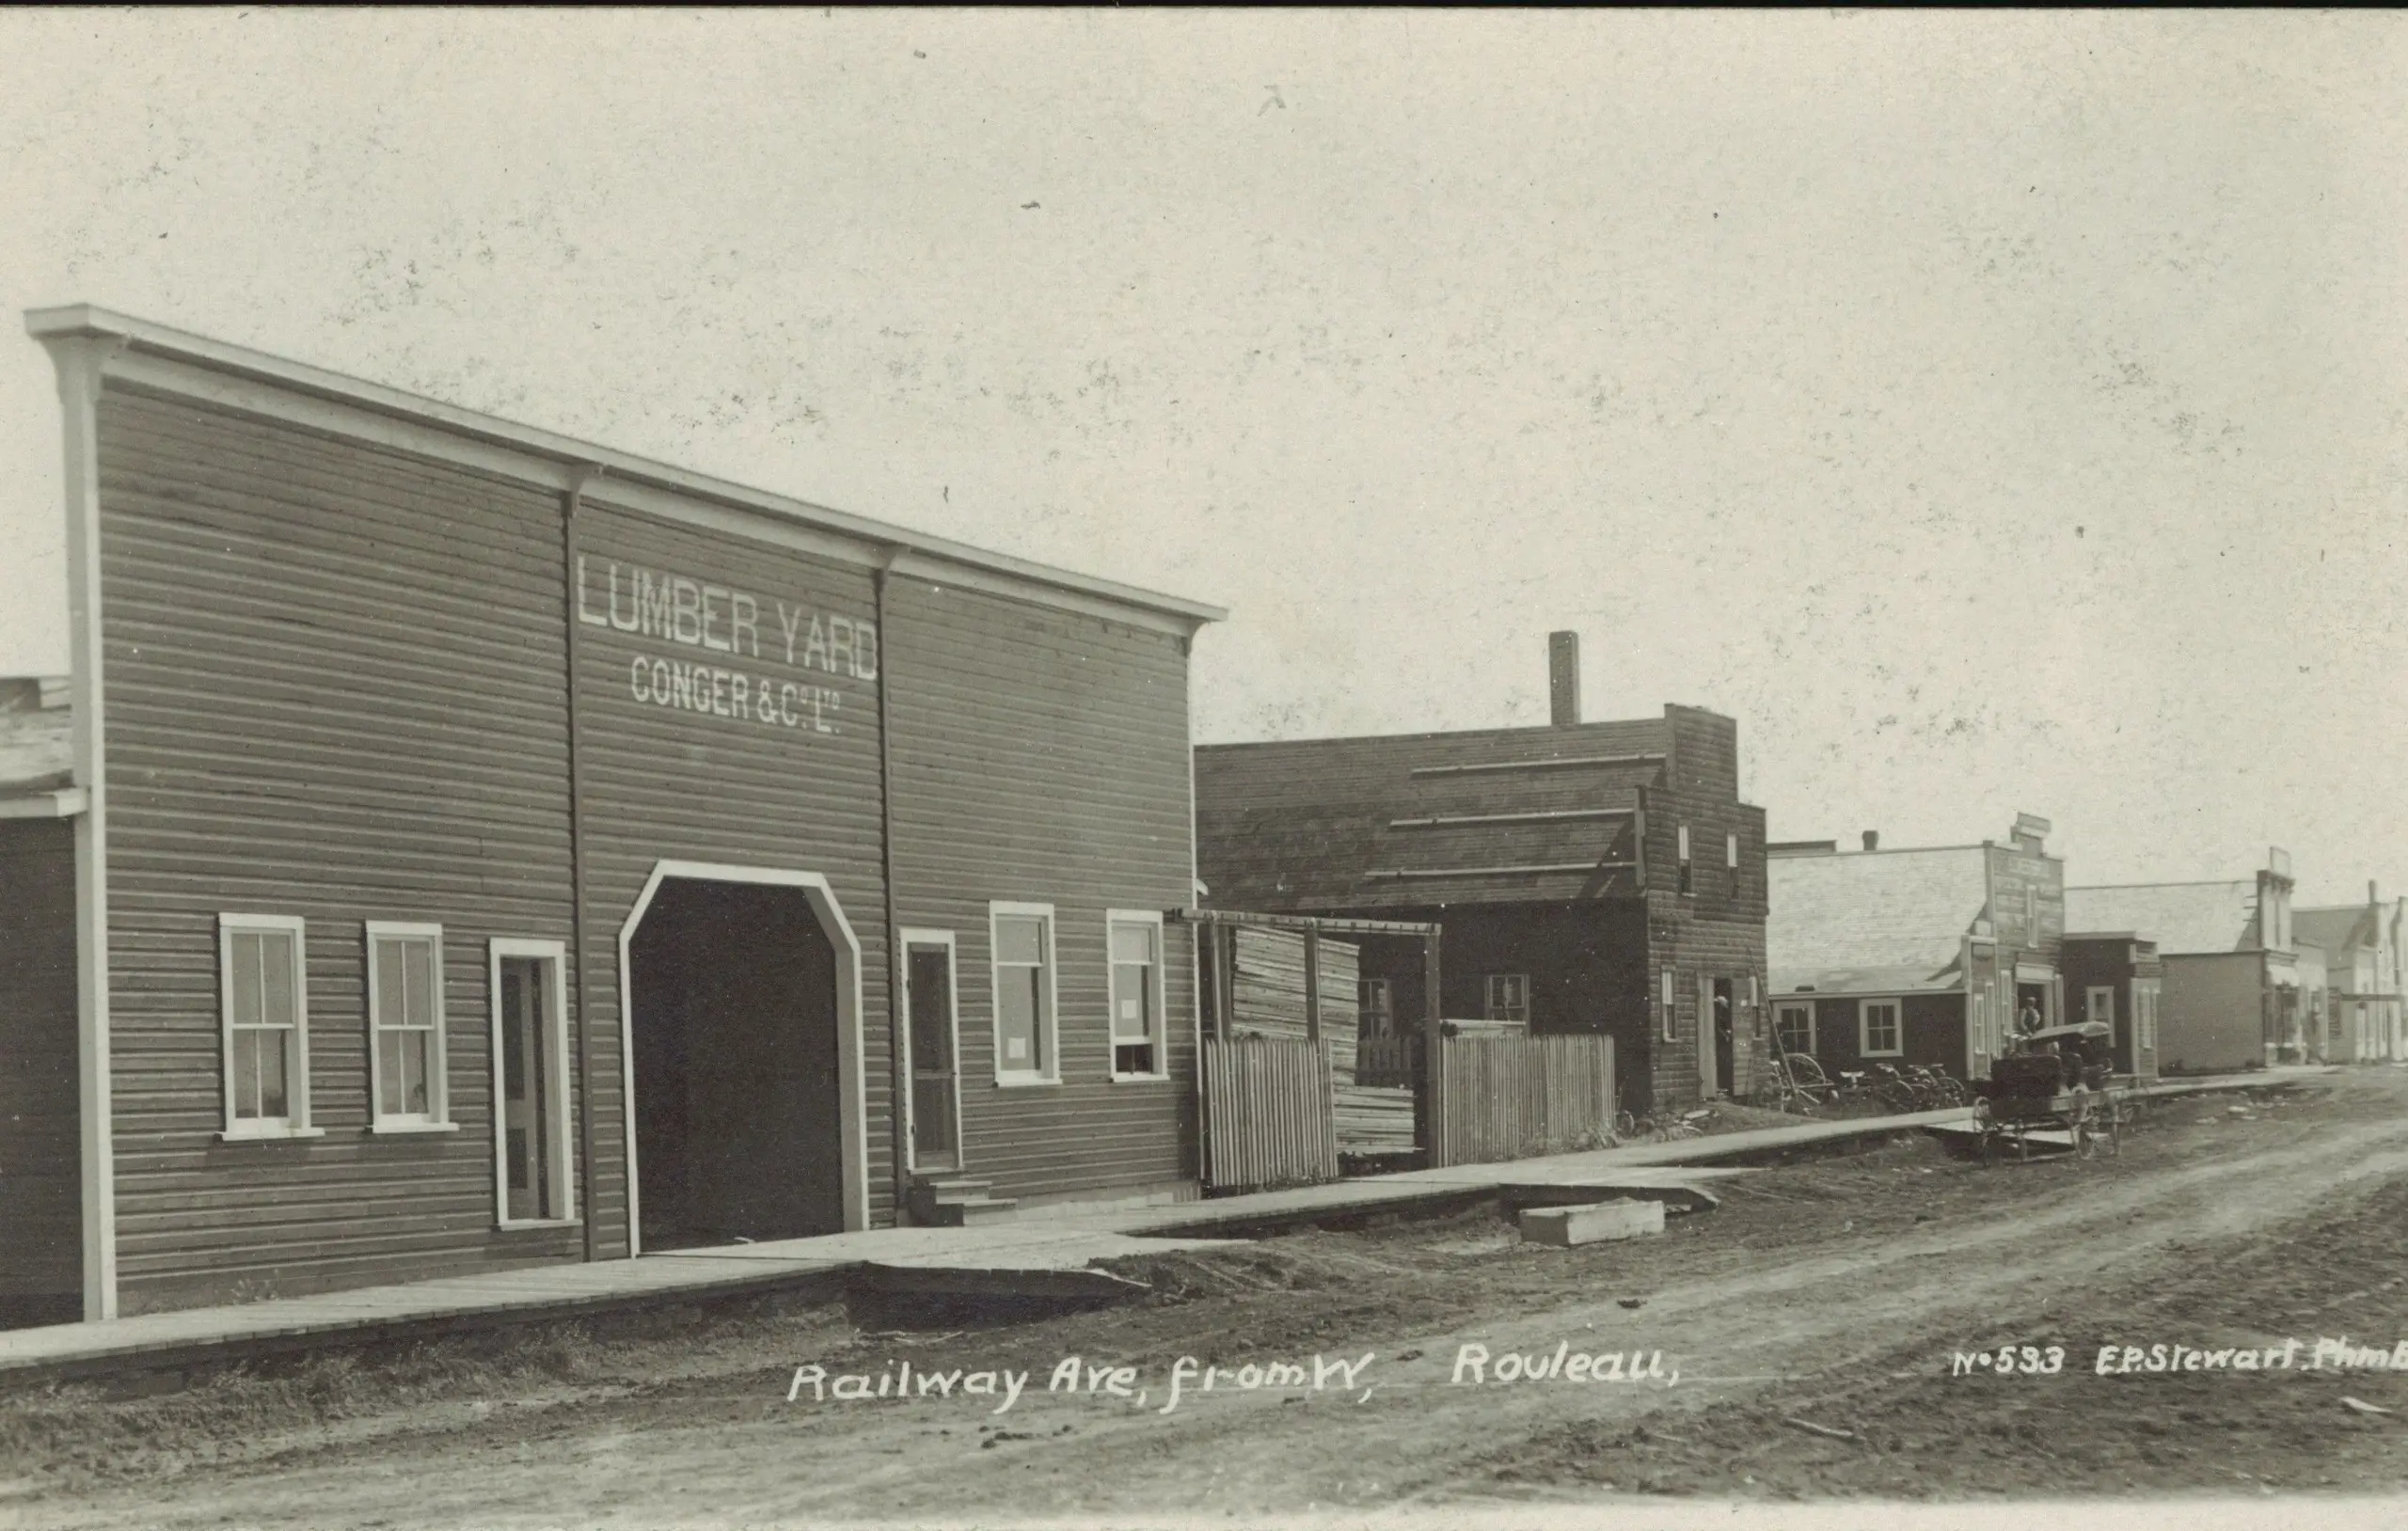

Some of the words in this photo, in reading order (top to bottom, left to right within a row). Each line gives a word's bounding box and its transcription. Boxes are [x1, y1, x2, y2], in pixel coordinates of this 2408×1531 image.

[577, 556, 759, 656] LUMBER
[777, 603, 878, 681] YARD
[631, 656, 749, 718] CONGER
[756, 680, 780, 725] &
